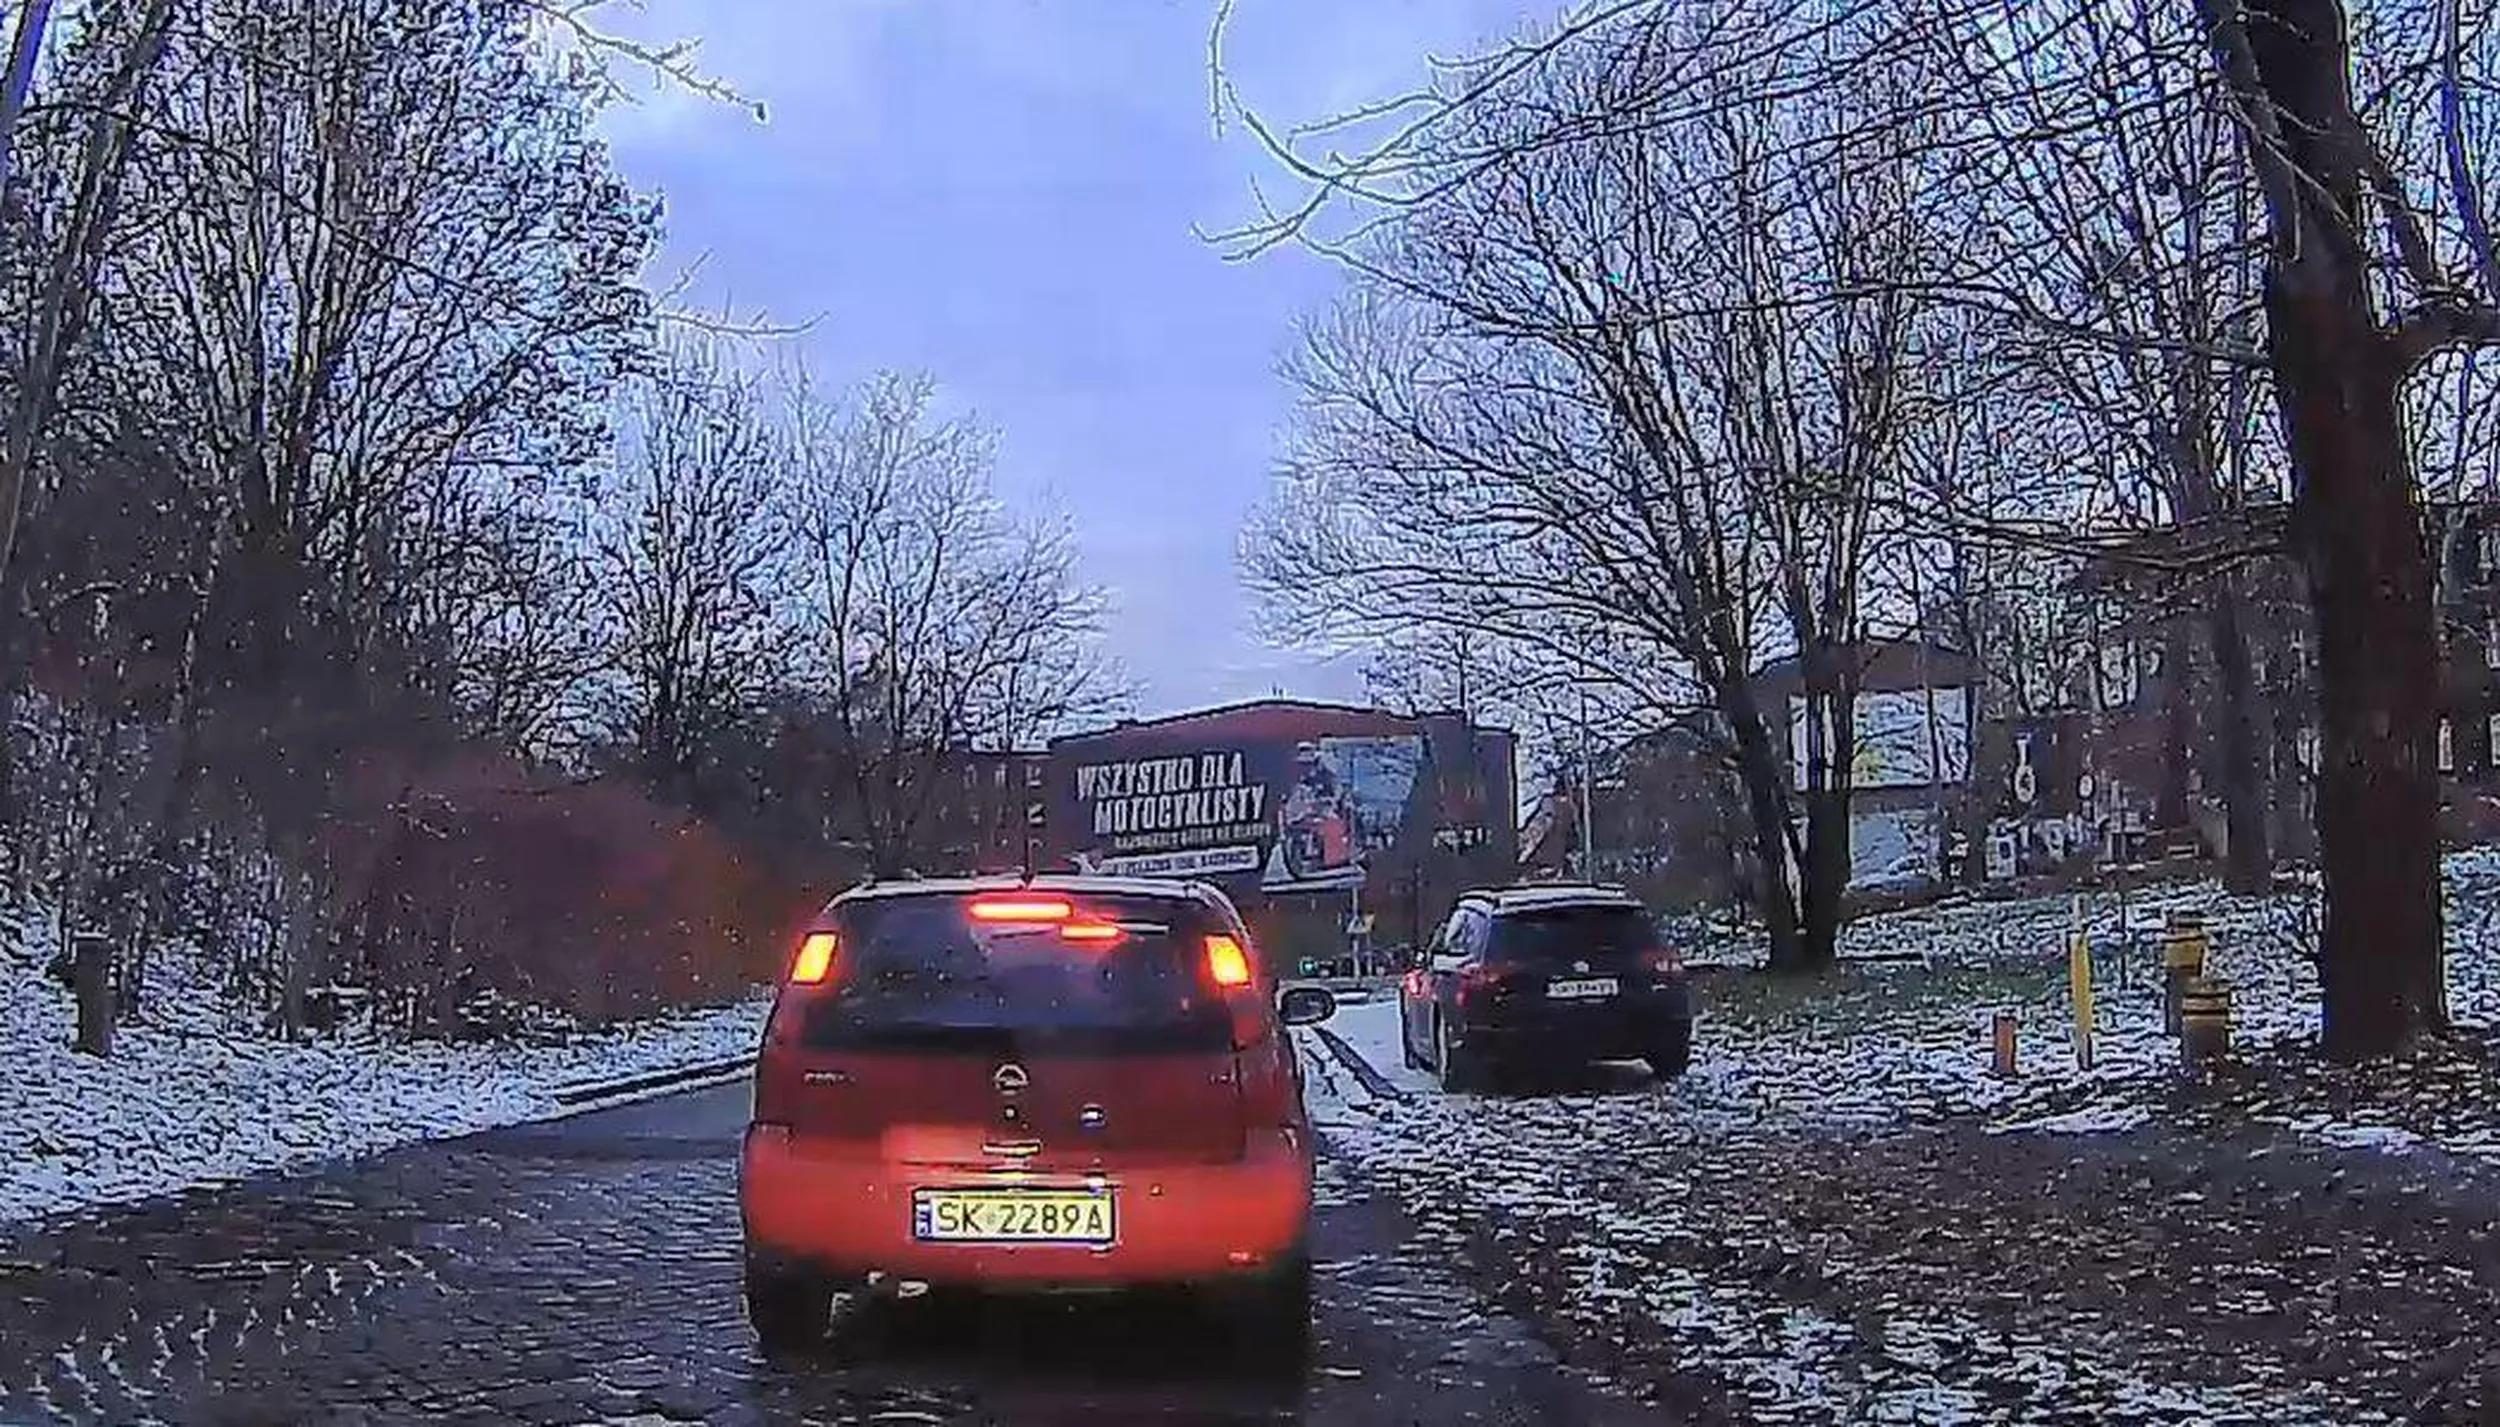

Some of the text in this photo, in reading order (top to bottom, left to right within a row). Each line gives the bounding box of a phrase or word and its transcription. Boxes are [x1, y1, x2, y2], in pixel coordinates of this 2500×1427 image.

[1077, 752, 1243, 801] WSZYSTKO DLA
[1094, 784, 1266, 835] MOTOCYKLISTY
[937, 1202, 1104, 1234] SK 2289A
